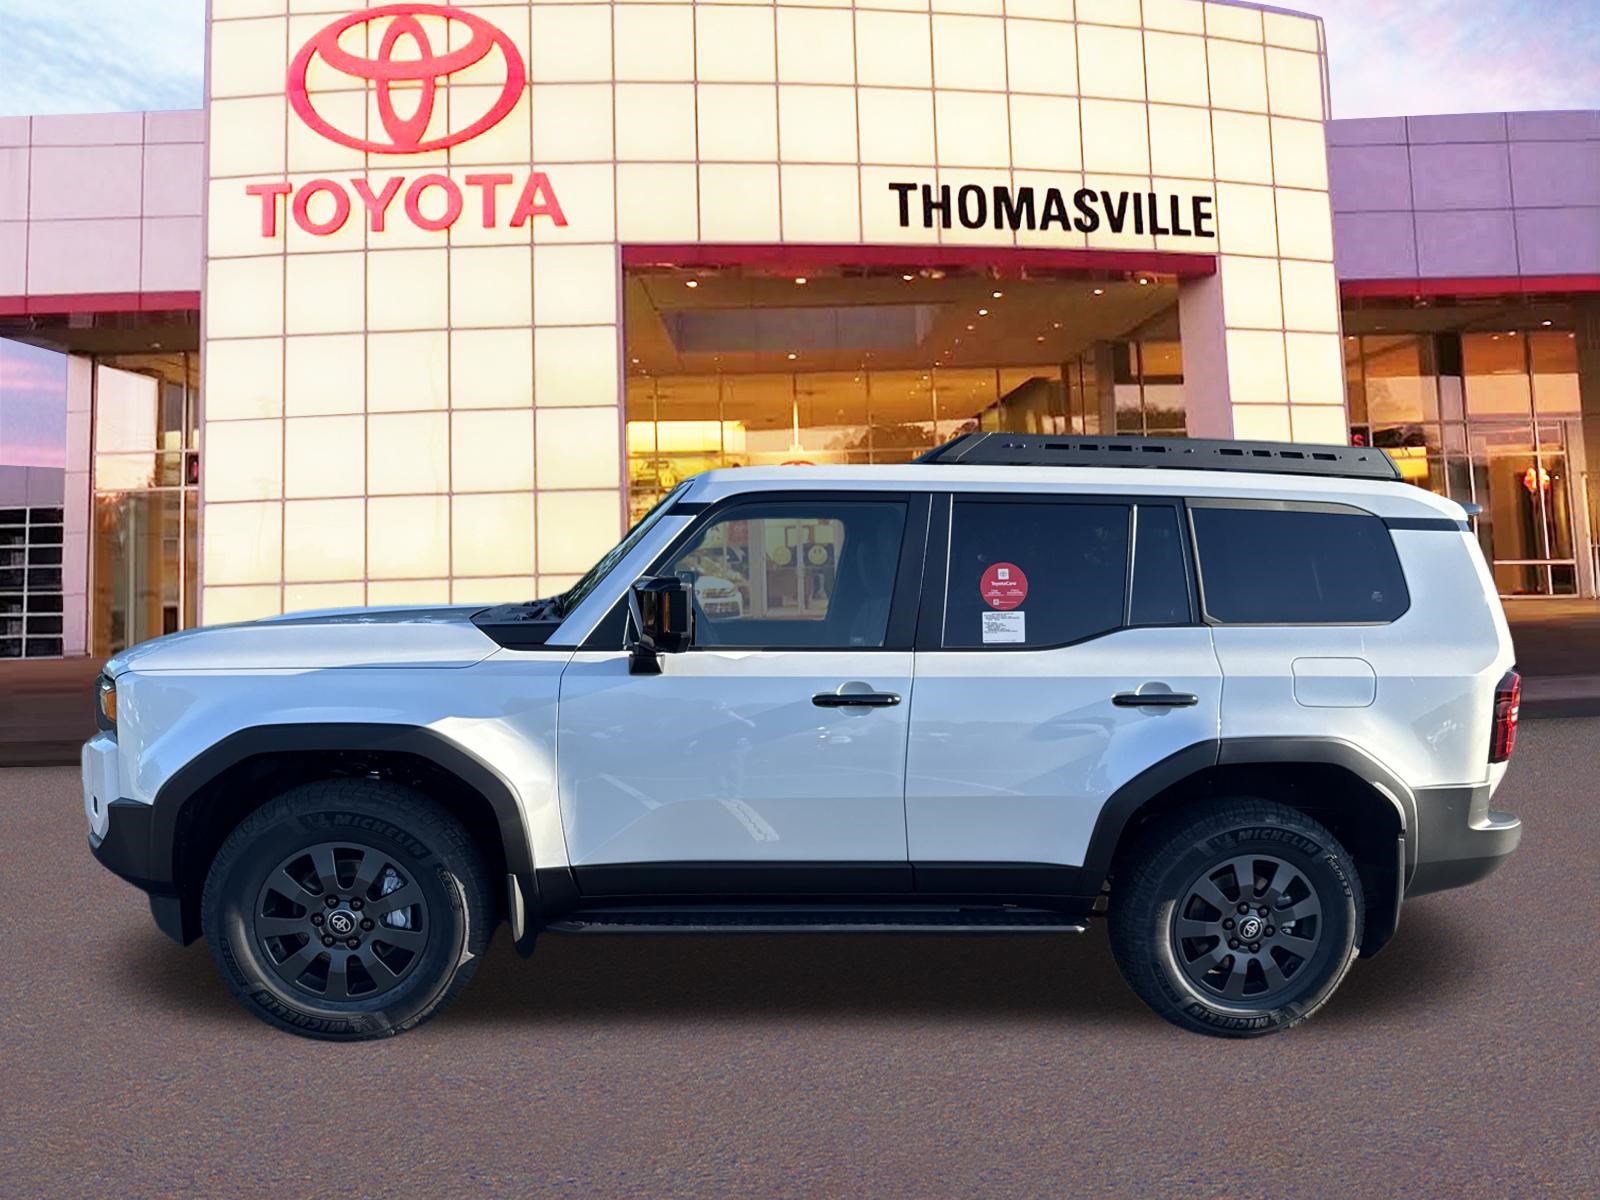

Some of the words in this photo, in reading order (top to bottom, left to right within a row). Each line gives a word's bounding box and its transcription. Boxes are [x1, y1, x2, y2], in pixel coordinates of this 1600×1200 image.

[246, 172, 568, 237] TOYOTA
[889, 183, 1215, 237] THOMASVILLE
[335, 815, 426, 856] MICHELIN
[1238, 829, 1319, 853] MICHELIN
[256, 990, 346, 1032] MICHELIN
[1188, 1003, 1269, 1028] MICHELIN
